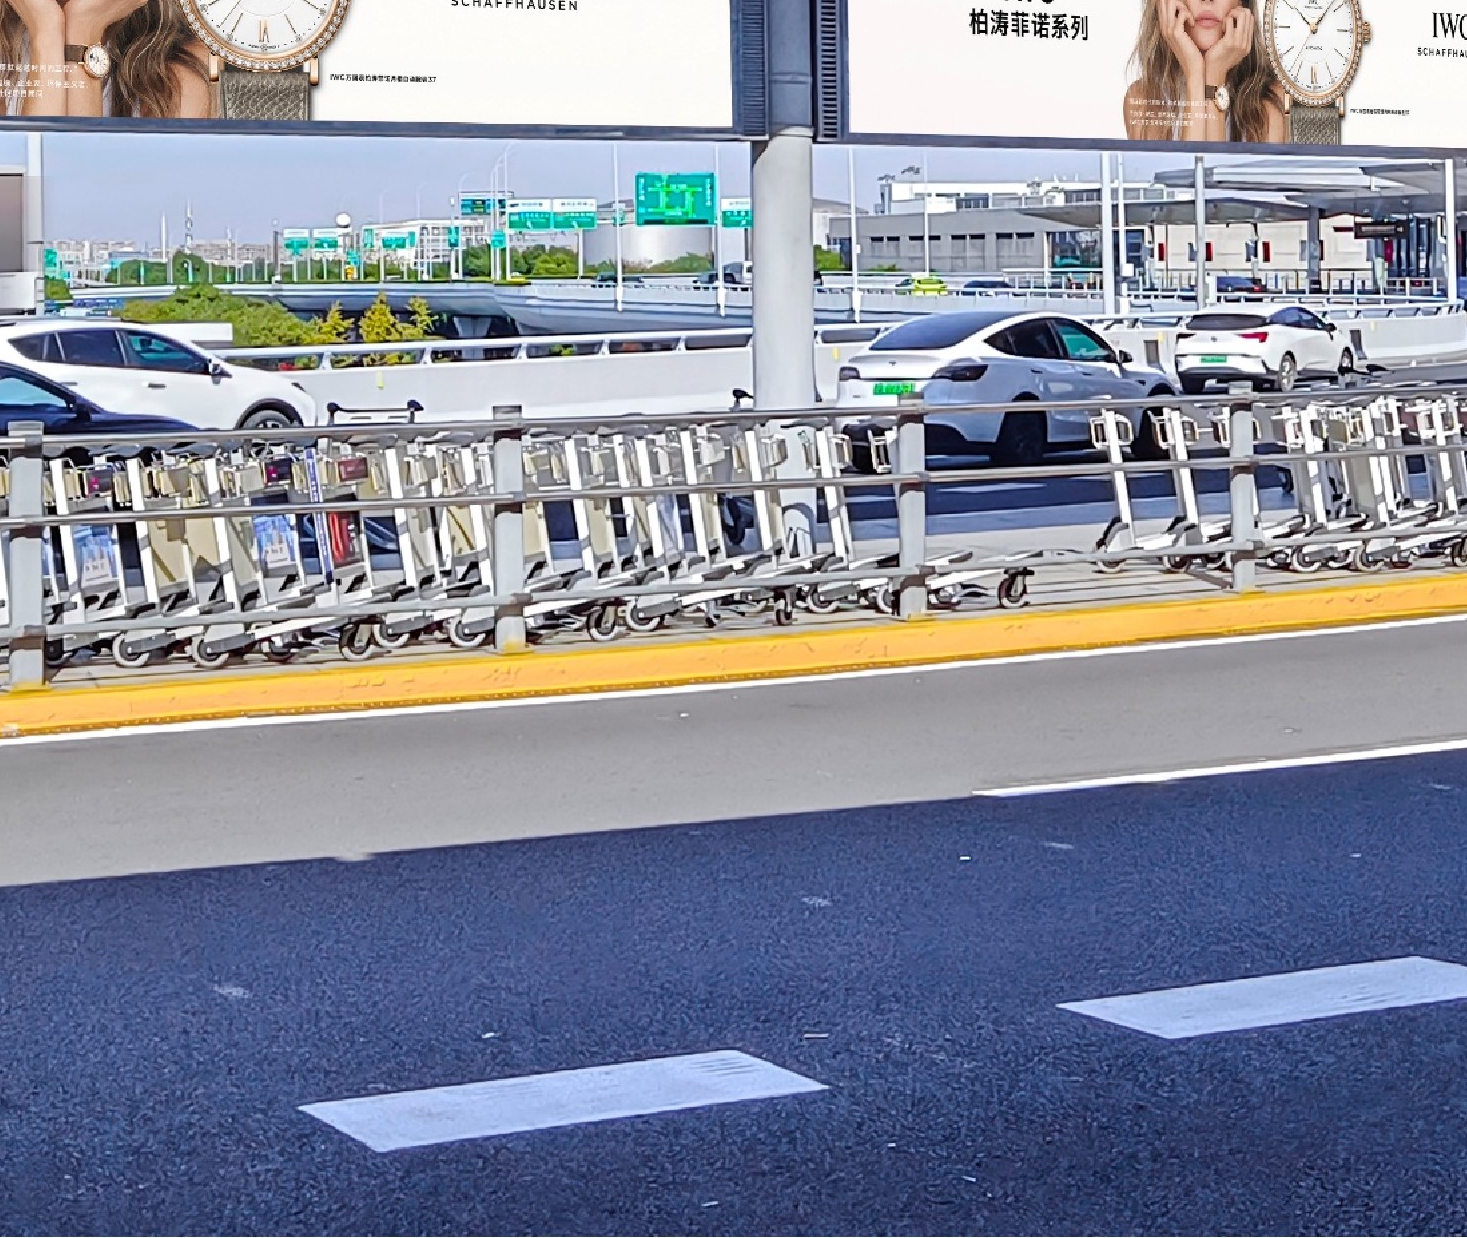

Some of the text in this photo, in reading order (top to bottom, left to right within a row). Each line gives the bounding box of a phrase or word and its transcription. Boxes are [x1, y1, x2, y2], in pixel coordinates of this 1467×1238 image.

[969, 8, 1089, 41] 柏涛菲诺系列
